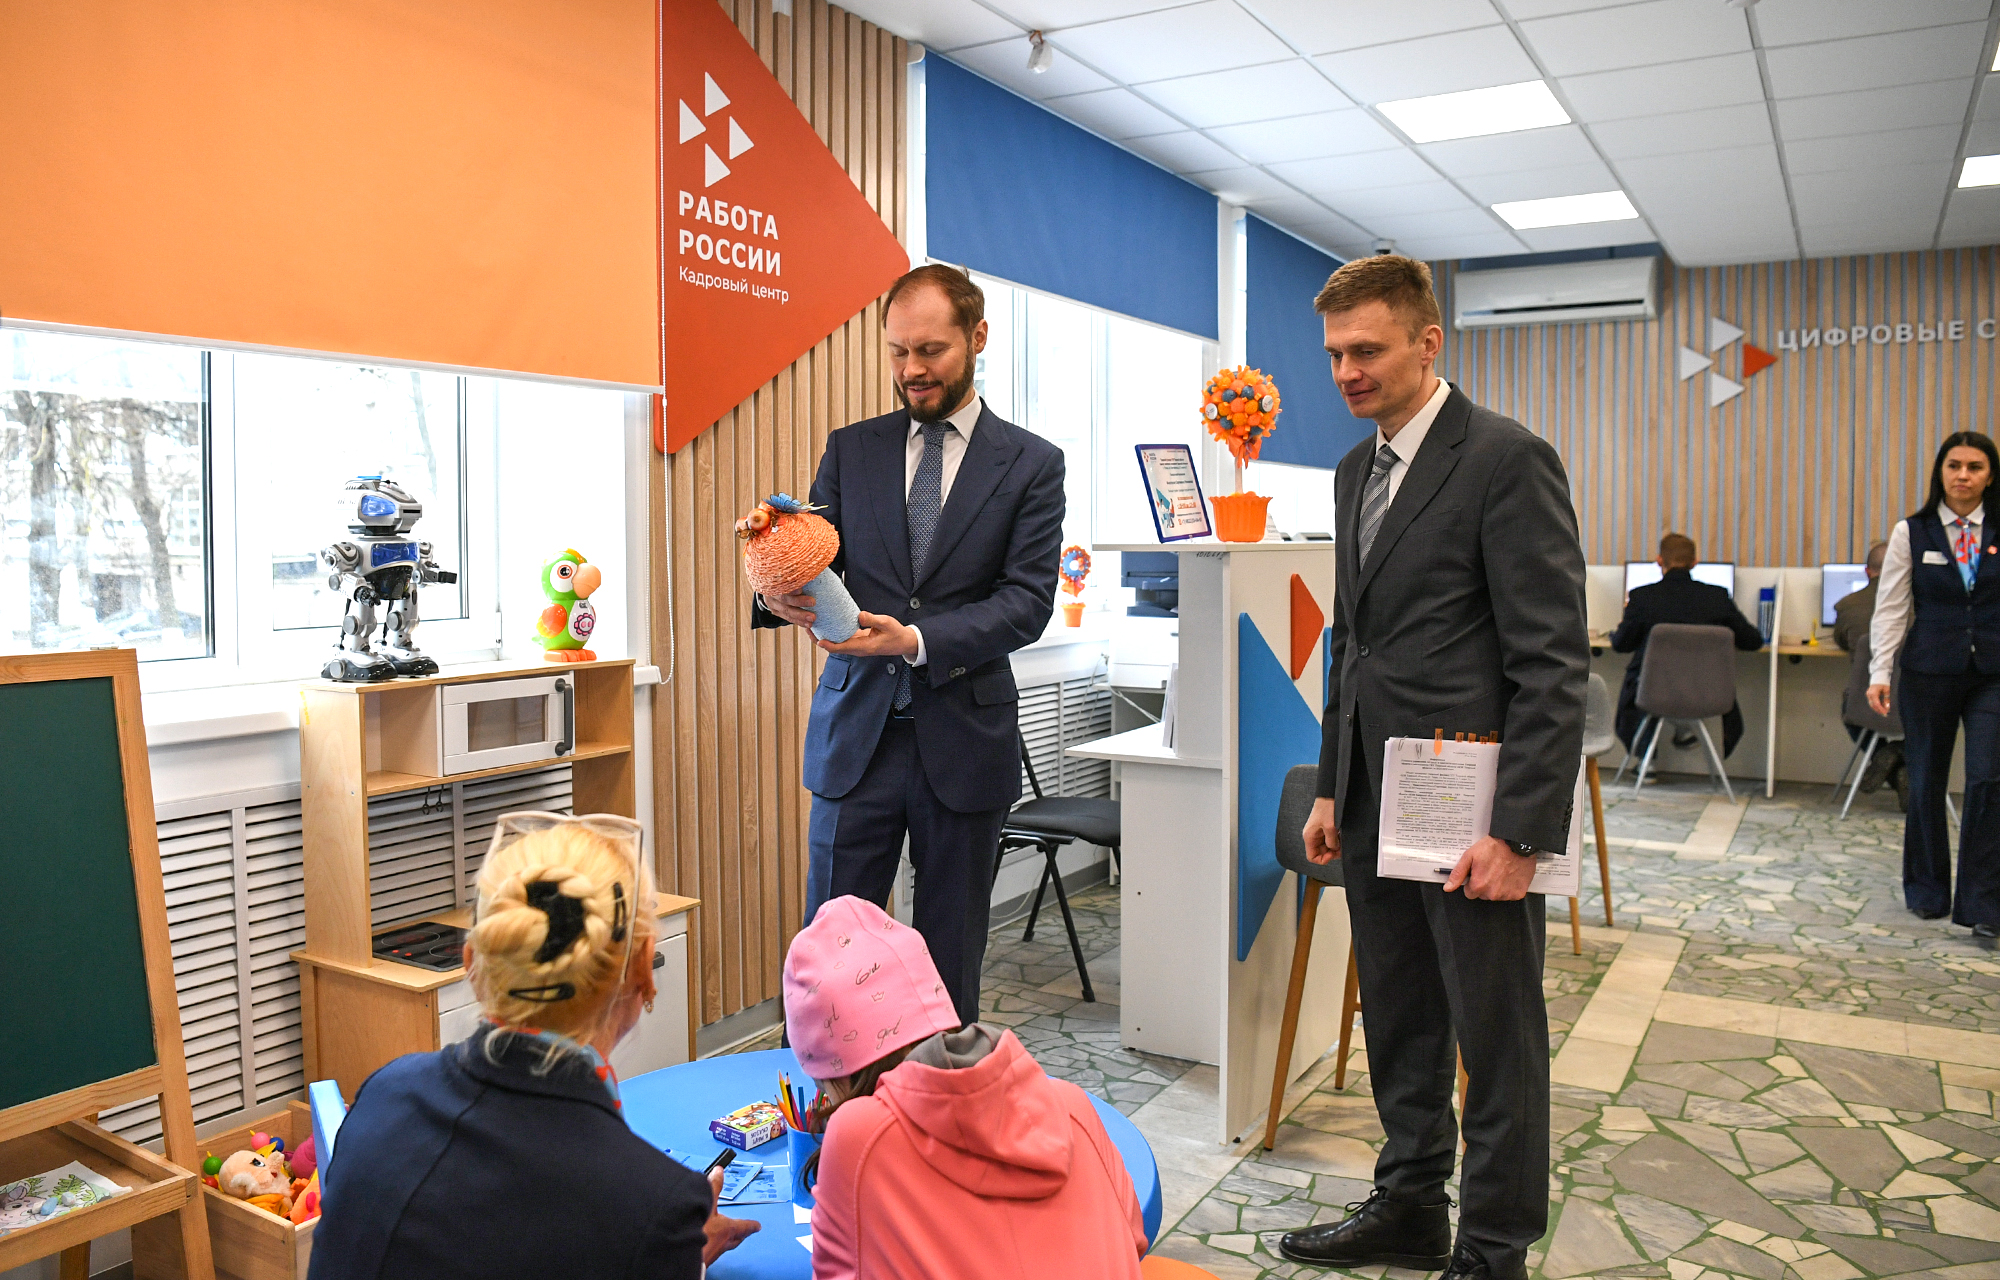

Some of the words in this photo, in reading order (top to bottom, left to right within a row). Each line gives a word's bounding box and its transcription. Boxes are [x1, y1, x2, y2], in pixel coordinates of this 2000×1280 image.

[679, 190, 779, 240] РАБОТА
[679, 229, 781, 276] РОССИИ
[679, 266, 749, 294] Кадровый
[752, 282, 789, 304] центр
[1778, 320, 1965, 352] ЦИФРОВЫЕ
